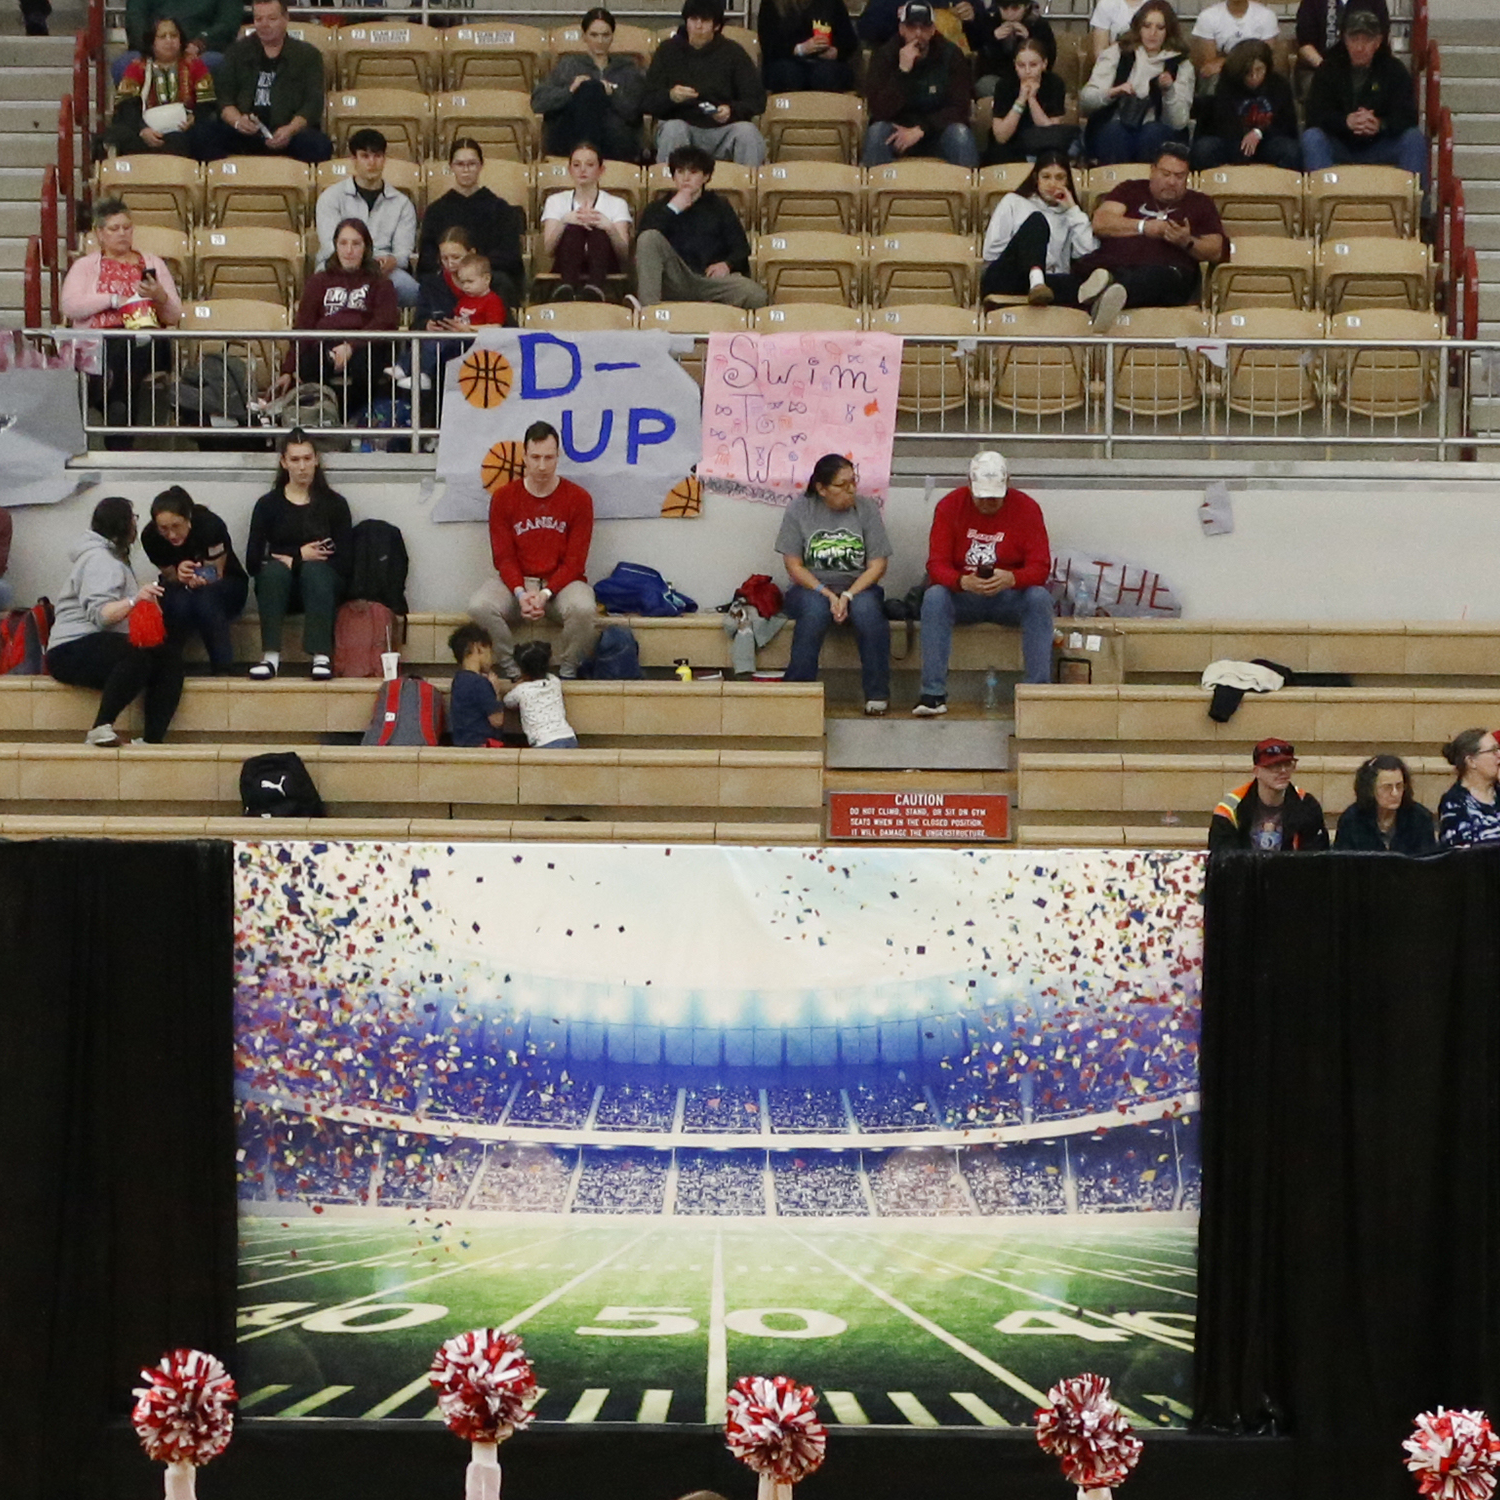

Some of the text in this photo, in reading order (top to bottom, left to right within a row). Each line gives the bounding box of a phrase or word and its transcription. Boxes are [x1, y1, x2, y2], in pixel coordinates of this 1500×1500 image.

[518, 332, 641, 399] D-
[723, 334, 878, 394] Swim
[561, 407, 676, 465] UP
[732, 436, 800, 485] Wi
[1091, 559, 1175, 612] THE
[850, 807, 859, 816] DO
[862, 807, 875, 816] NOT
[932, 807, 942, 816] OR
[944, 807, 955, 816] SIT
[958, 807, 968, 816] ON
[971, 807, 986, 816] GYM
[895, 794, 944, 806] CAUTION
[861, 829, 876, 837] WILL
[910, 829, 922, 837] THE
[874, 818, 893, 827] WHEN
[896, 818, 903, 827] IN
[907, 818, 919, 827] THE
[922, 818, 948, 827] CLOSED
[575, 1306, 848, 1340] 50
